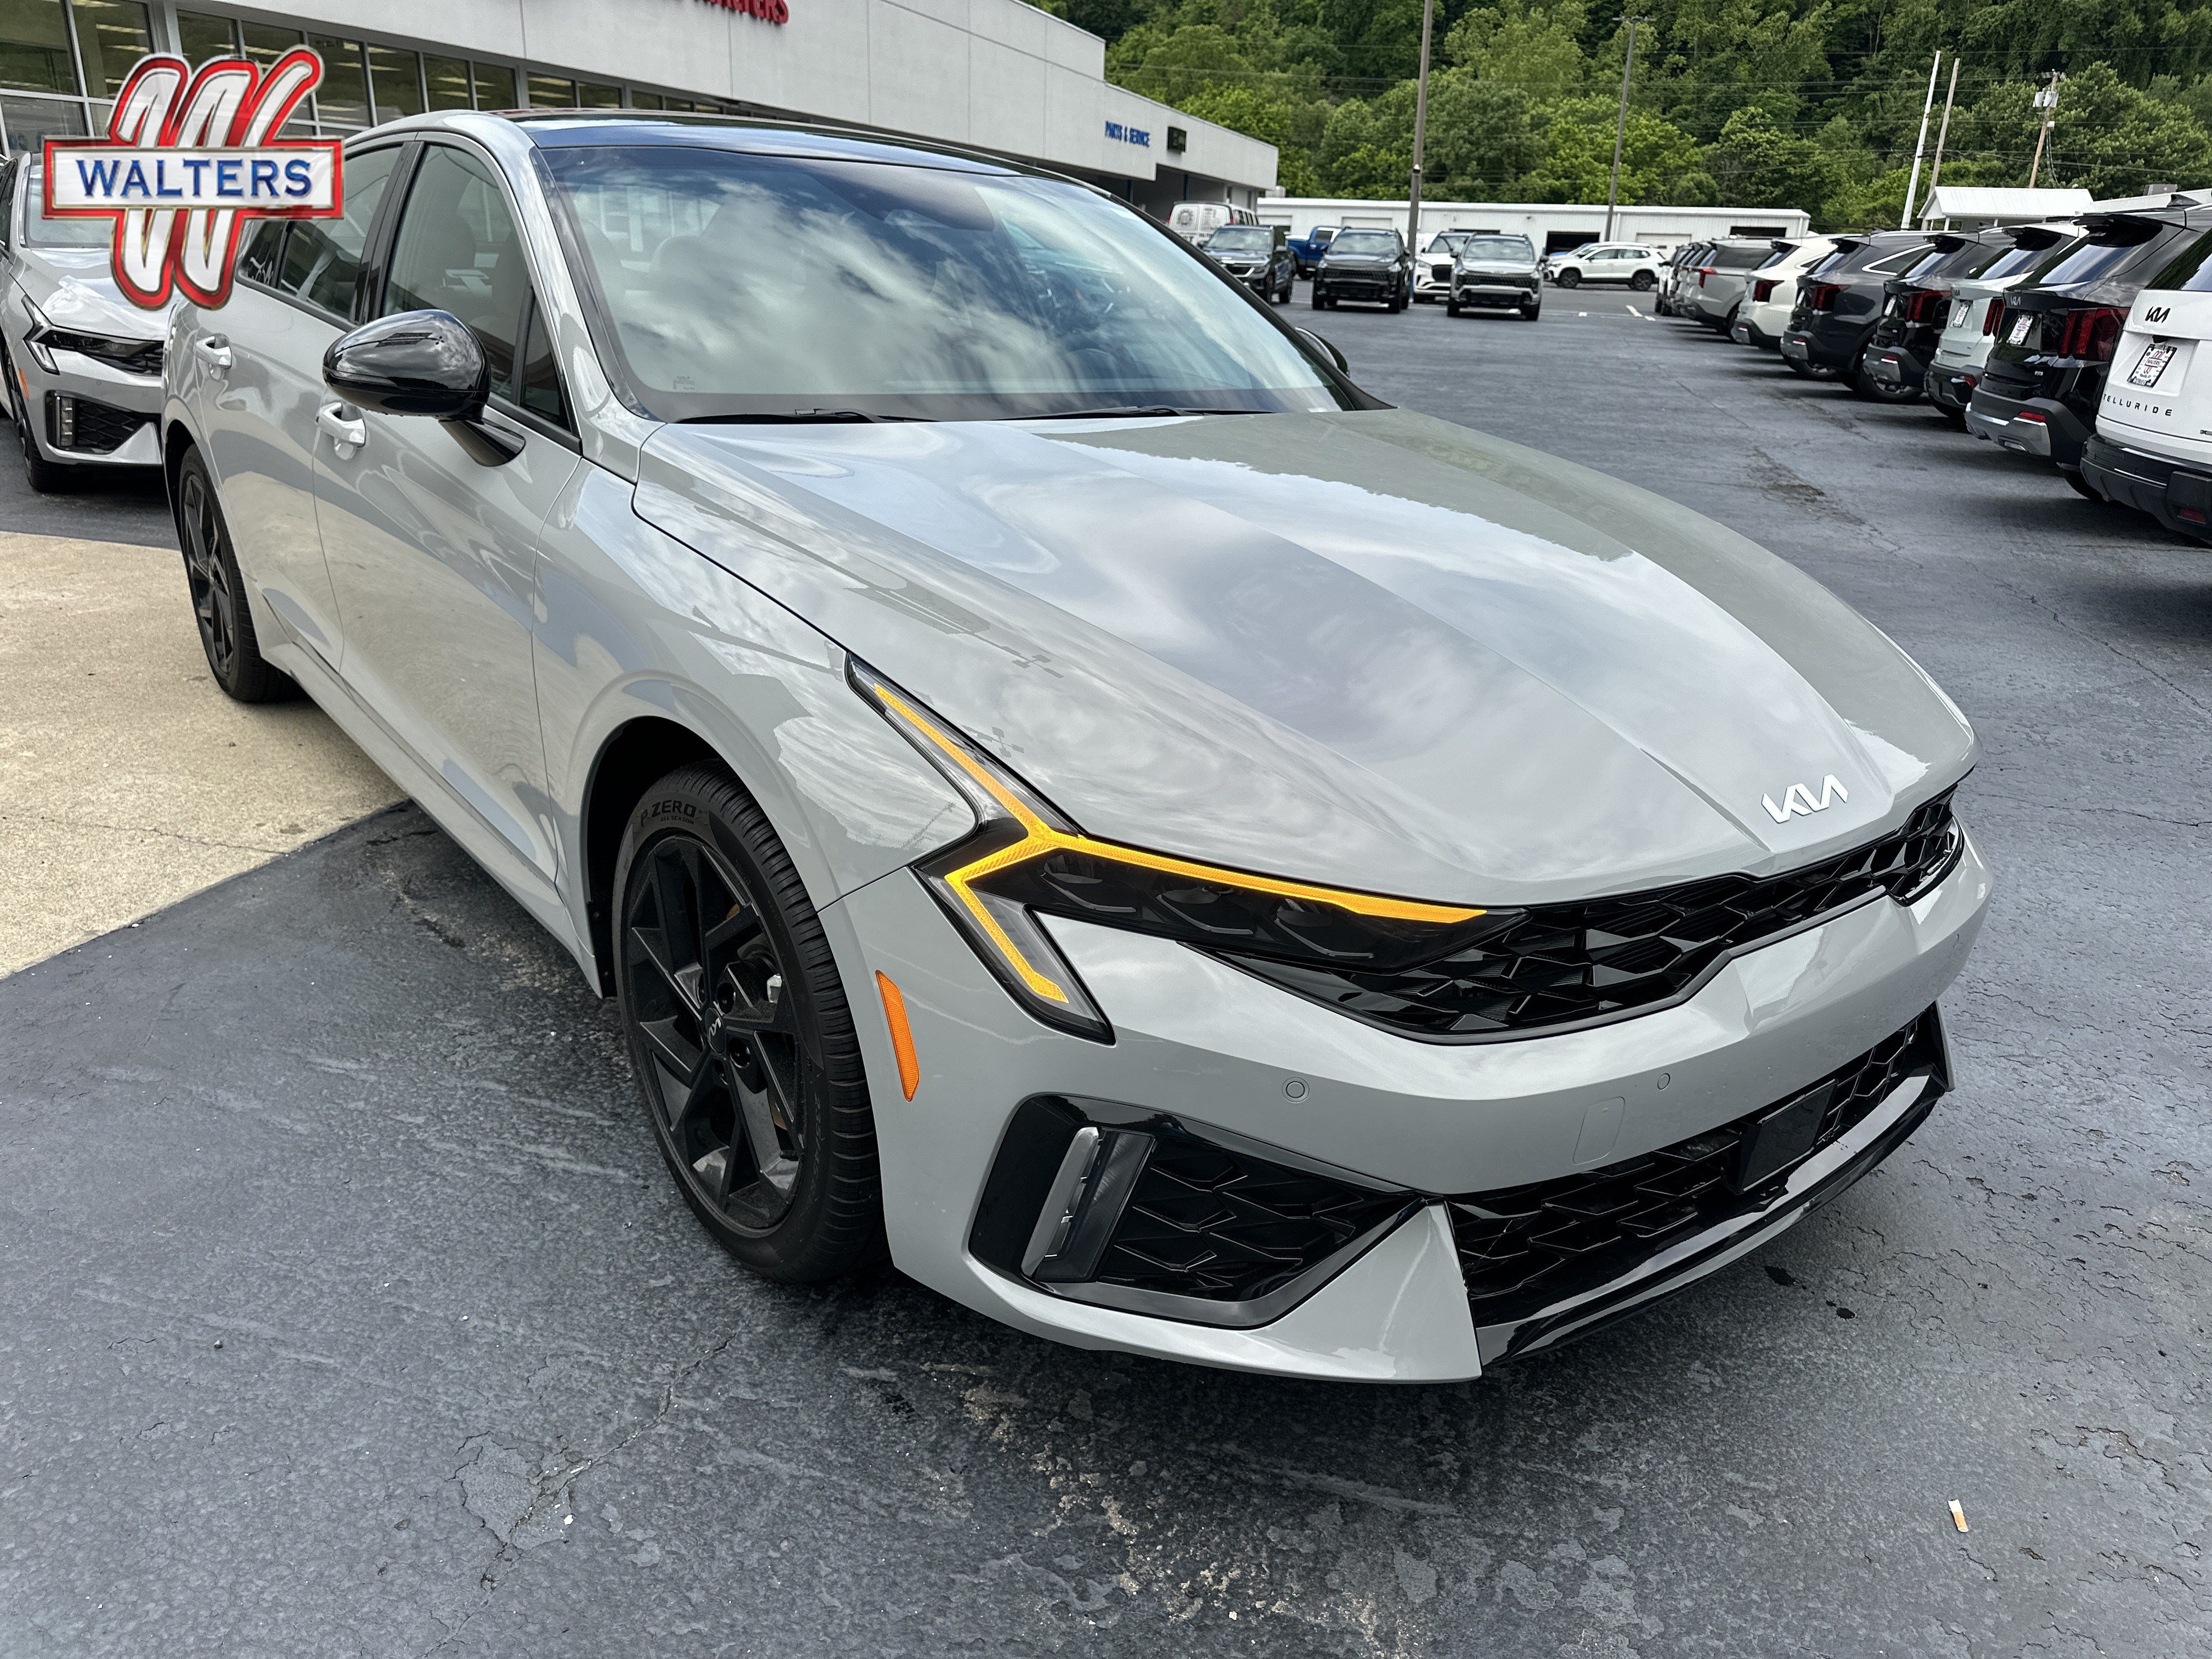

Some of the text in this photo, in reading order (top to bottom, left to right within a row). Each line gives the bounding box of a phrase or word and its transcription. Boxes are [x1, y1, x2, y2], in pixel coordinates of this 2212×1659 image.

[2103, 393, 2172, 417] TELLURIDE
[1761, 774, 1849, 824] KIA
[640, 799, 697, 827] P ZERO
[670, 815, 694, 826] SEASON
